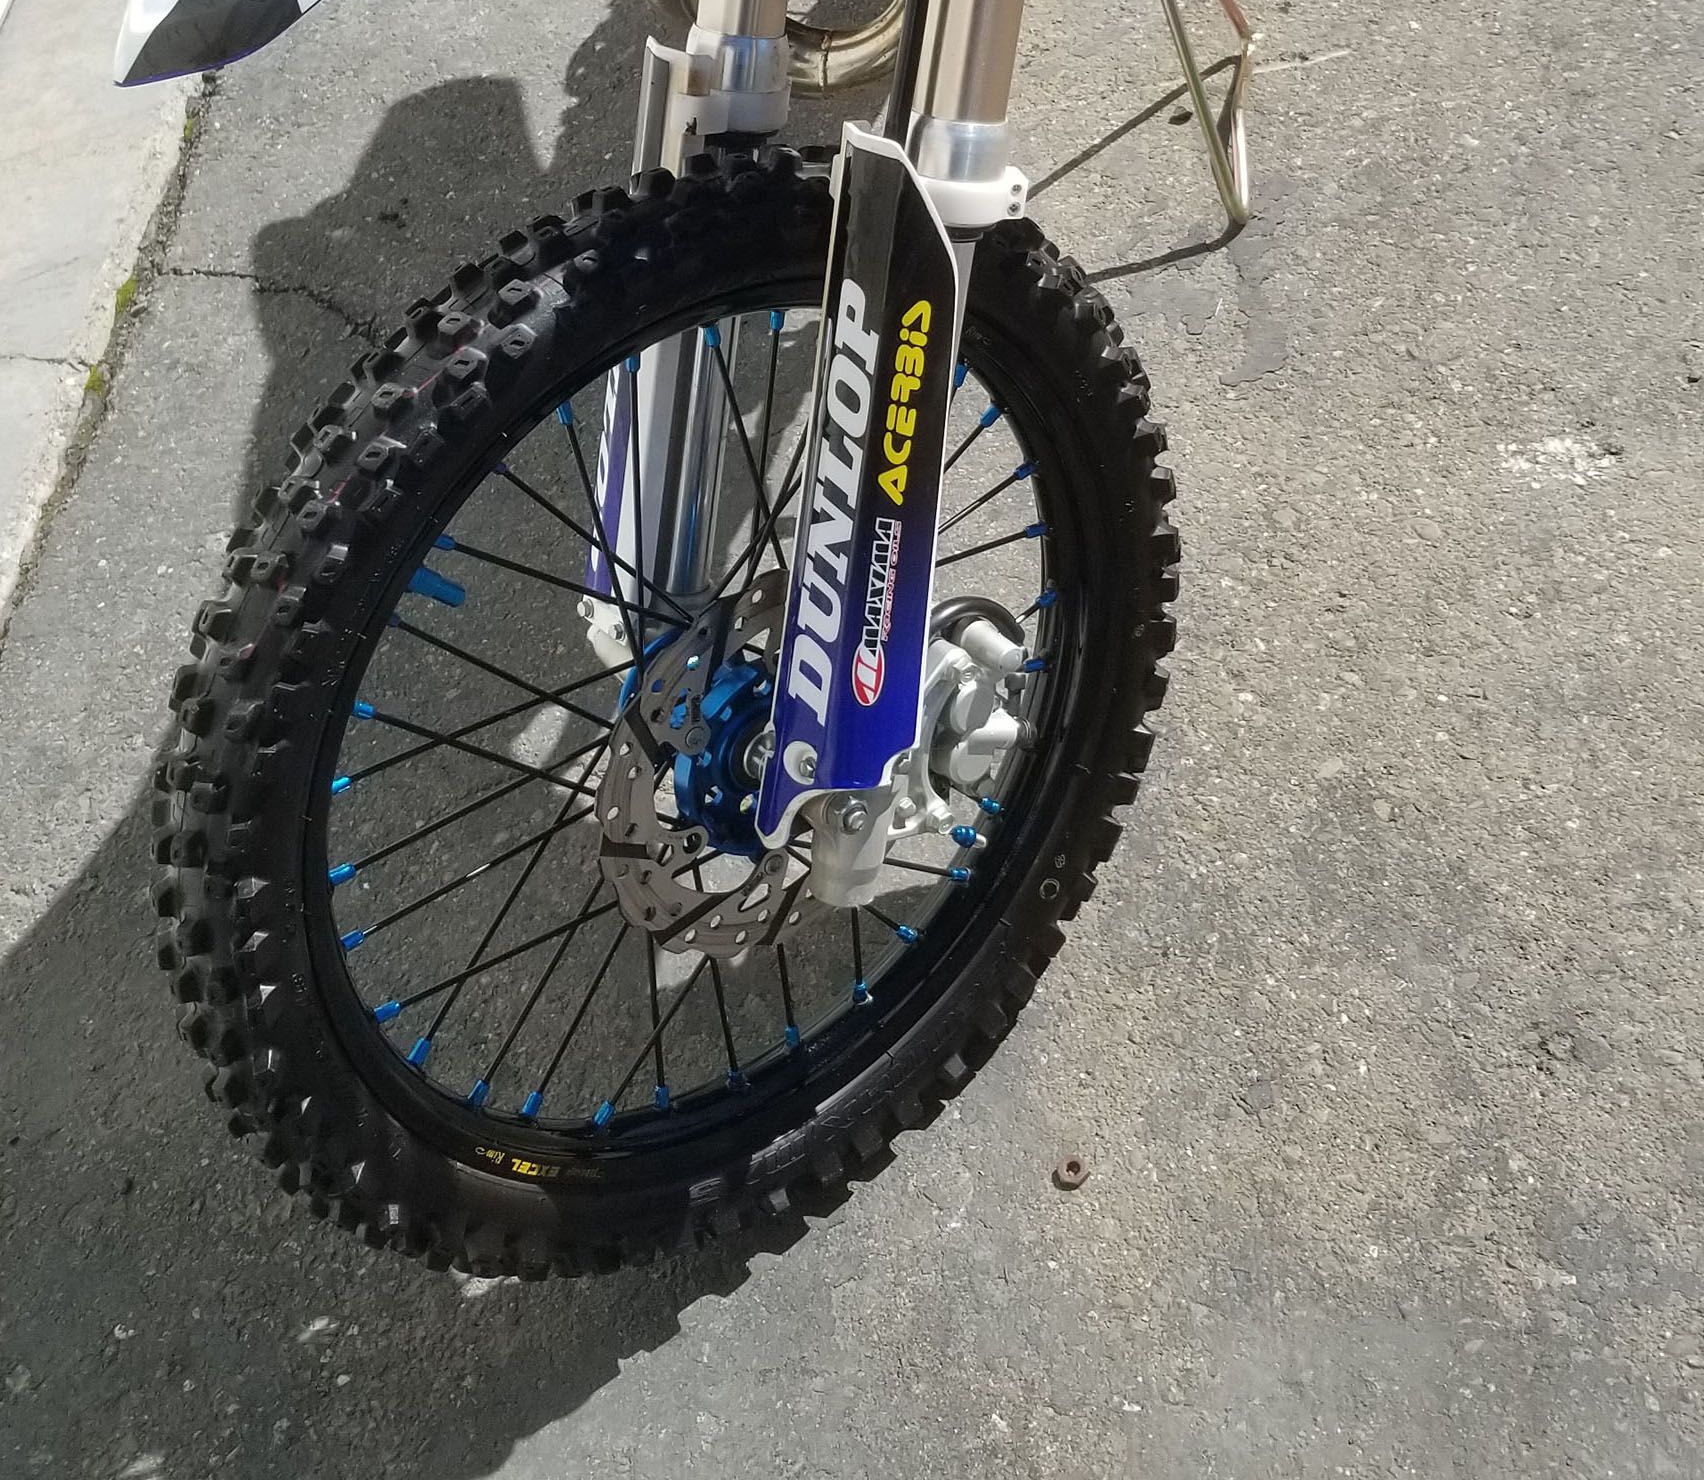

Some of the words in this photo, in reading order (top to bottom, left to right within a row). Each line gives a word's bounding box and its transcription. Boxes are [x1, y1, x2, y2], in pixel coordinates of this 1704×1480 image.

[788, 278, 881, 727] DUNLOP
[862, 517, 898, 658] MAXIMA
[511, 1158, 561, 1178] EXCEL
